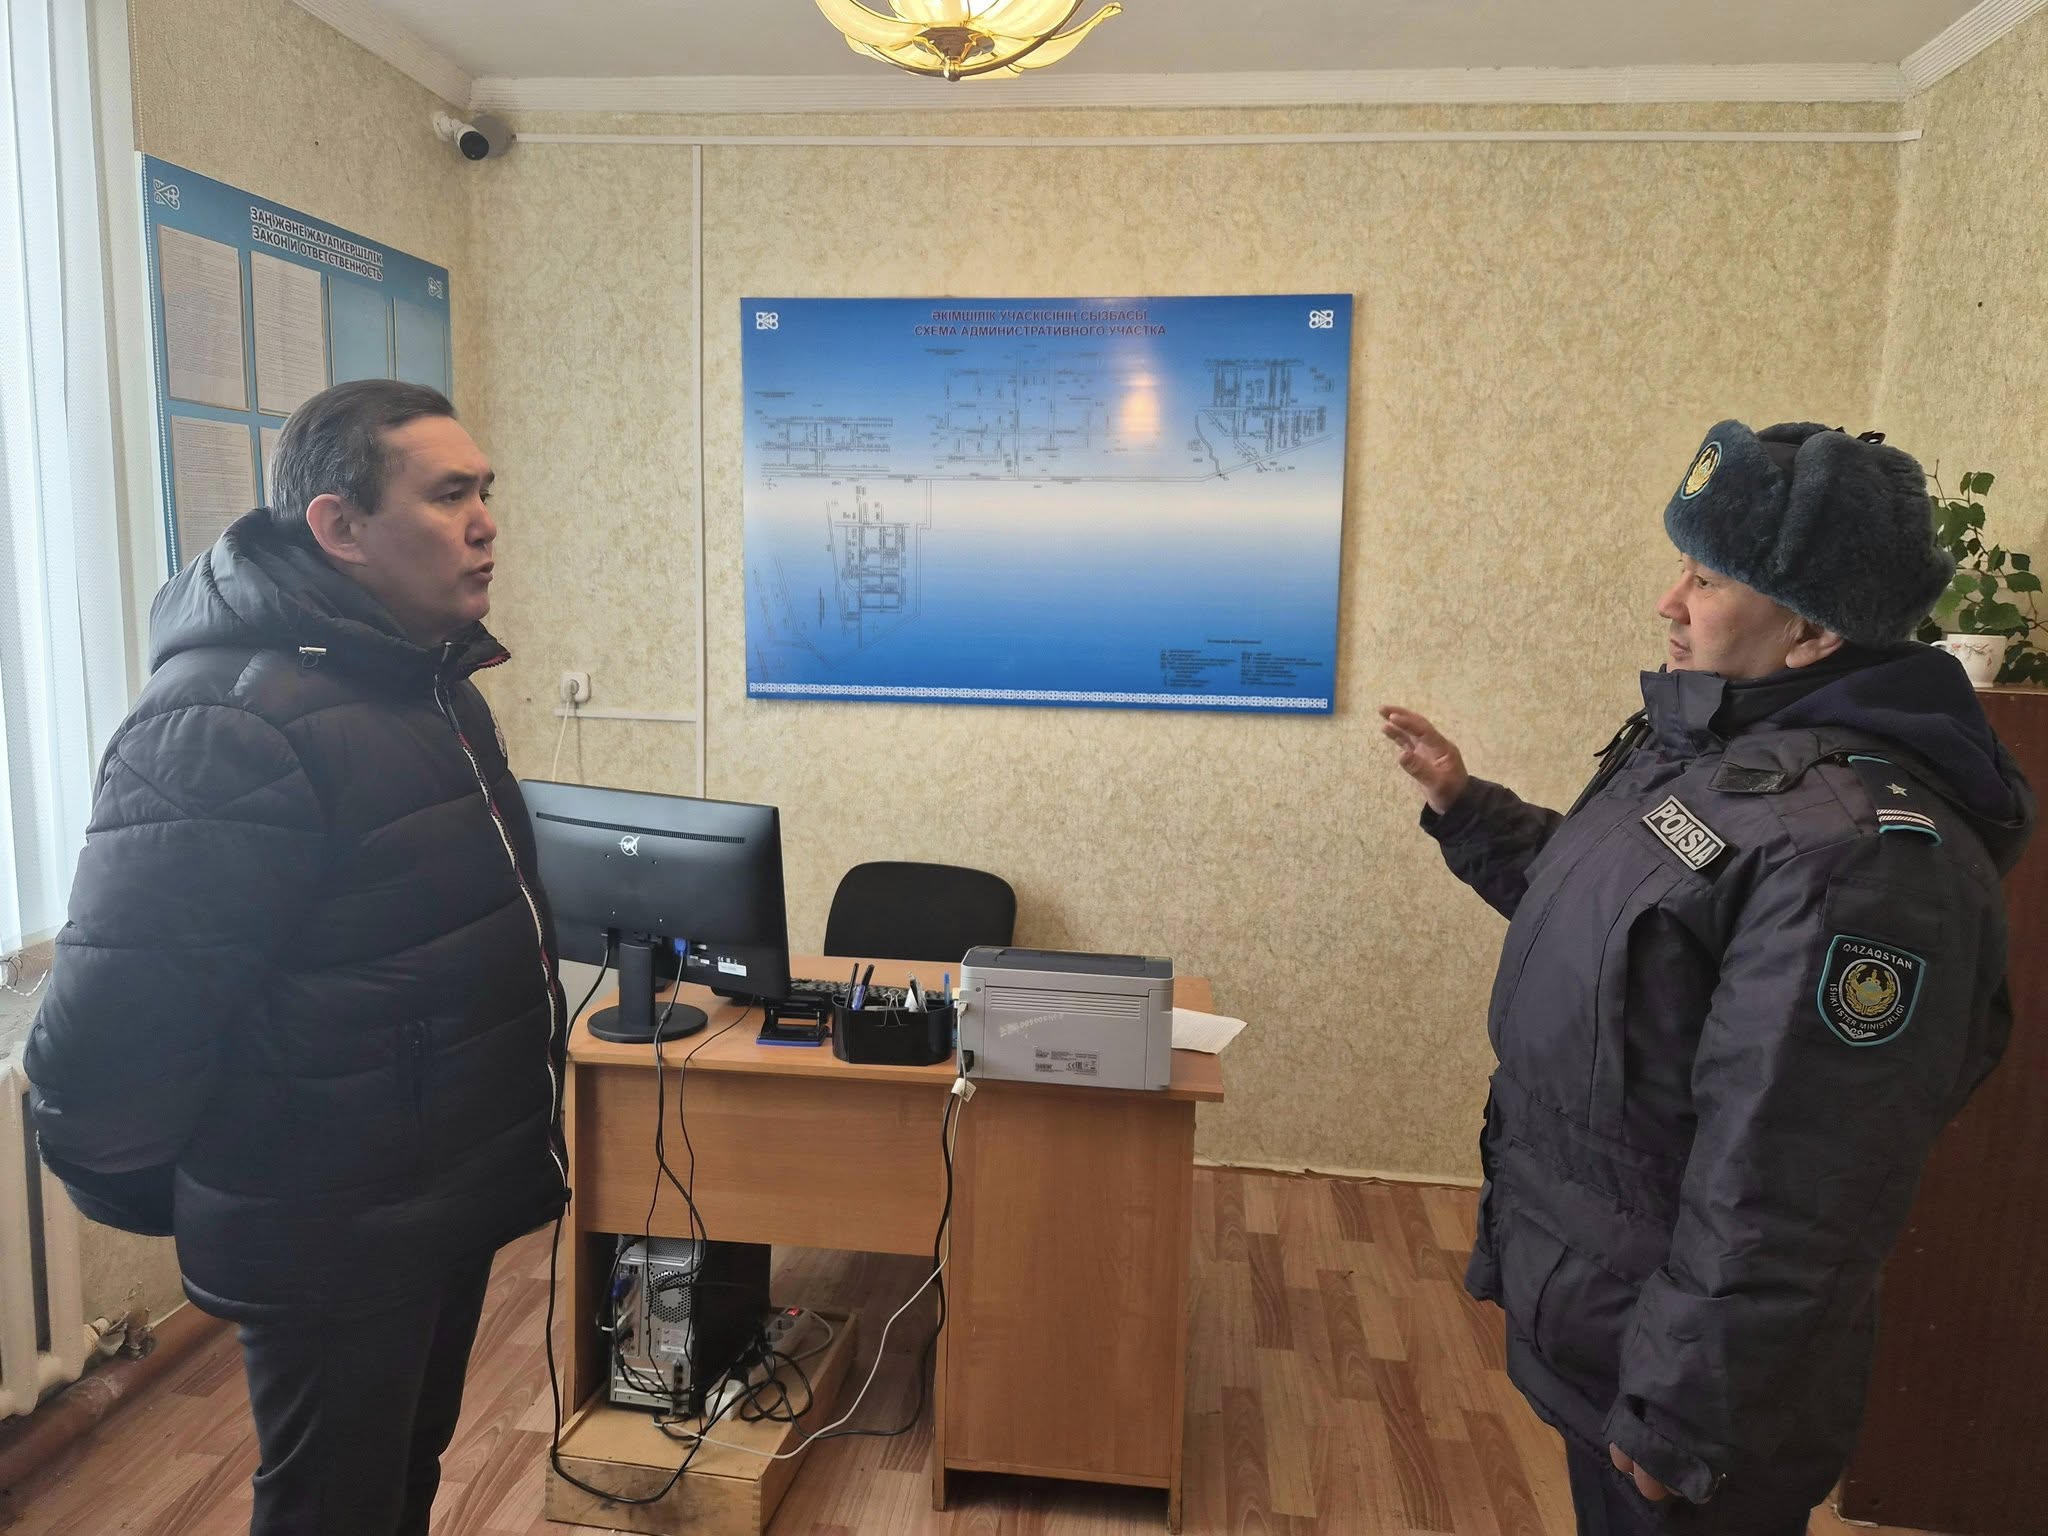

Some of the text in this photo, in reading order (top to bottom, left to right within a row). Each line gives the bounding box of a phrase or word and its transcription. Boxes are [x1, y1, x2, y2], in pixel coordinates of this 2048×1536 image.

[251, 207, 383, 265] ЗАҢ ЖӘНЕ ЖАУАПКЕРШІЛІК
[253, 226, 383, 281] ЗАКОН И ОТВЕТСТВЕННОСТЬ
[932, 310, 1148, 323] ӘКІМШІЛІК УЧАСКІСІНІҢ СЫЗБАСЫ
[914, 325, 1166, 338] СХЕМА АДМИНИСТРАТИВНОГО УЧАСТКА
[1649, 802, 1718, 866] POLISIA
[1842, 943, 1912, 970] QAZAQSTAN
[1836, 1005, 1857, 1027] ISTER
[1859, 1004, 1905, 1030] MINISTRLIGI
